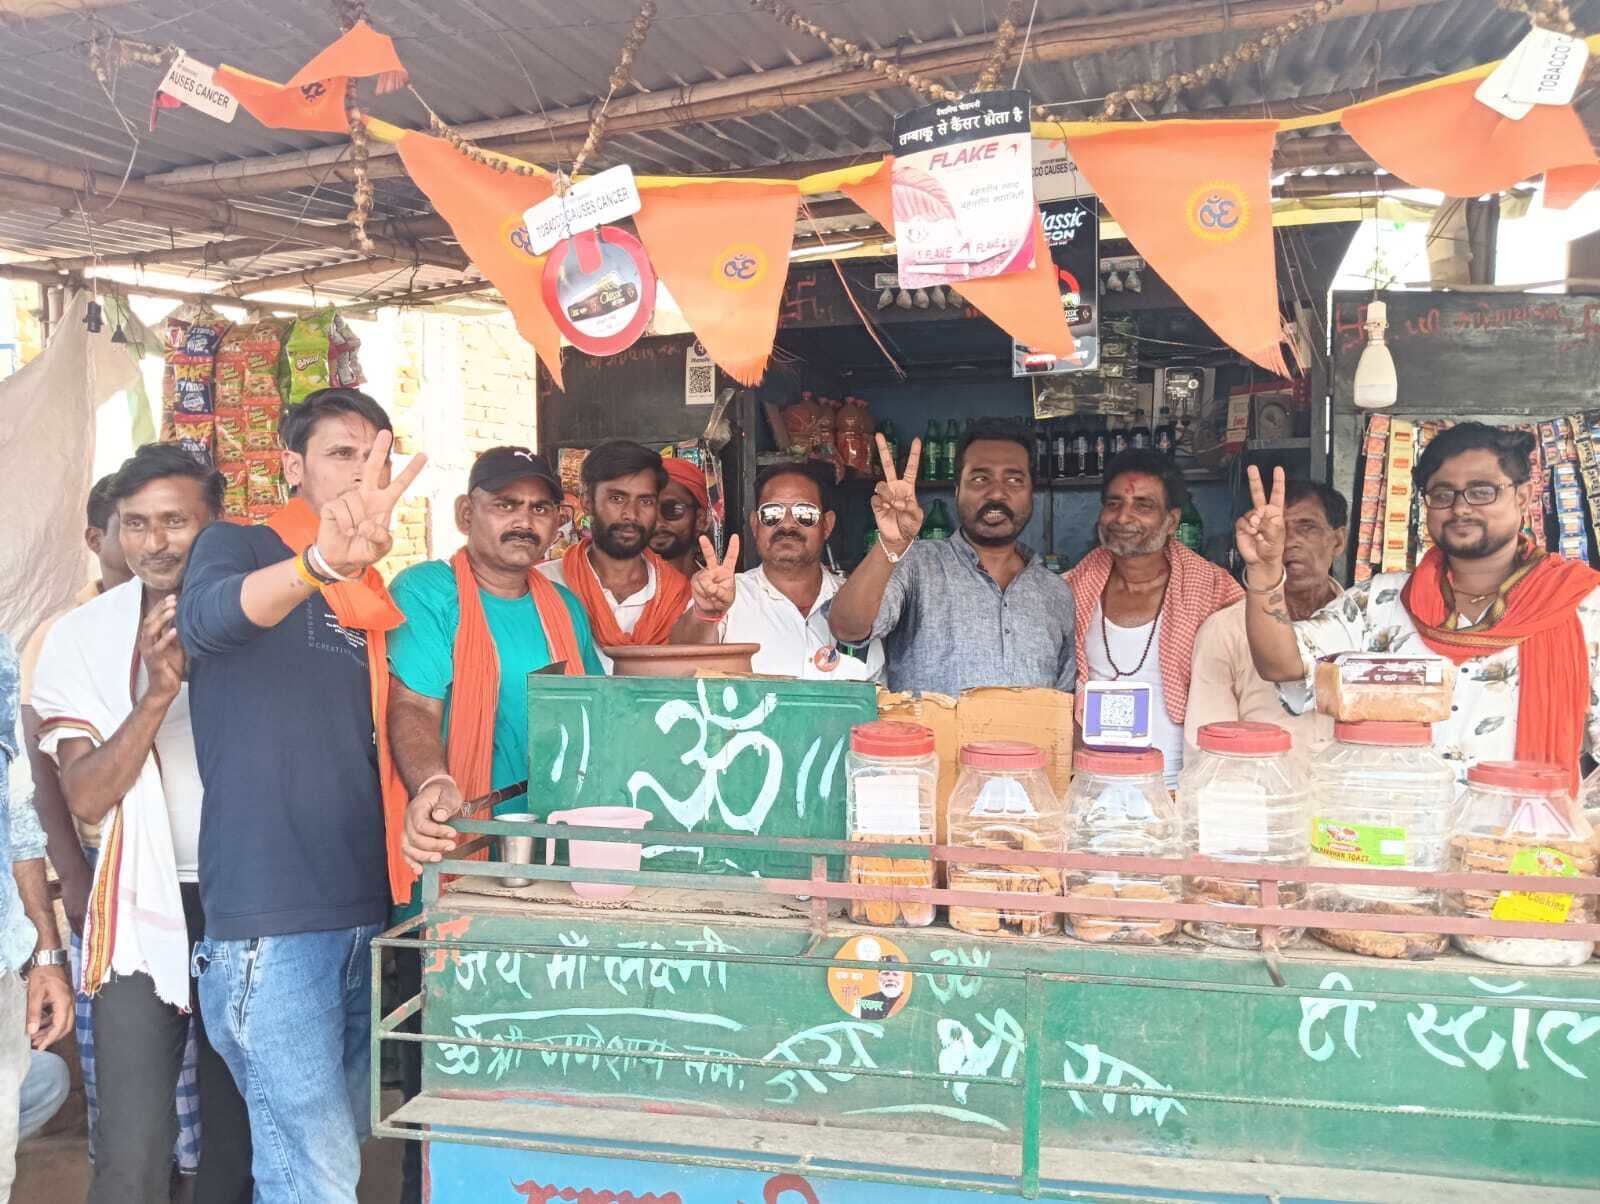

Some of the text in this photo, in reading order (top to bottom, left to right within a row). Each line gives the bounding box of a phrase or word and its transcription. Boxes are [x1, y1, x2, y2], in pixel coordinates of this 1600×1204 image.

[1537, 45, 1571, 92] TOBACCO
[195, 83, 230, 108] CANCER
[899, 105, 1024, 147] तम्बाकू से कैंसर होता है
[928, 142, 999, 171] FLAKE
[1044, 162, 1068, 176] CAUSES
[565, 198, 597, 222] CAUSES
[597, 186, 631, 211] CANCER
[455, 950, 533, 999] जय
[1299, 971, 1377, 1062] टी
